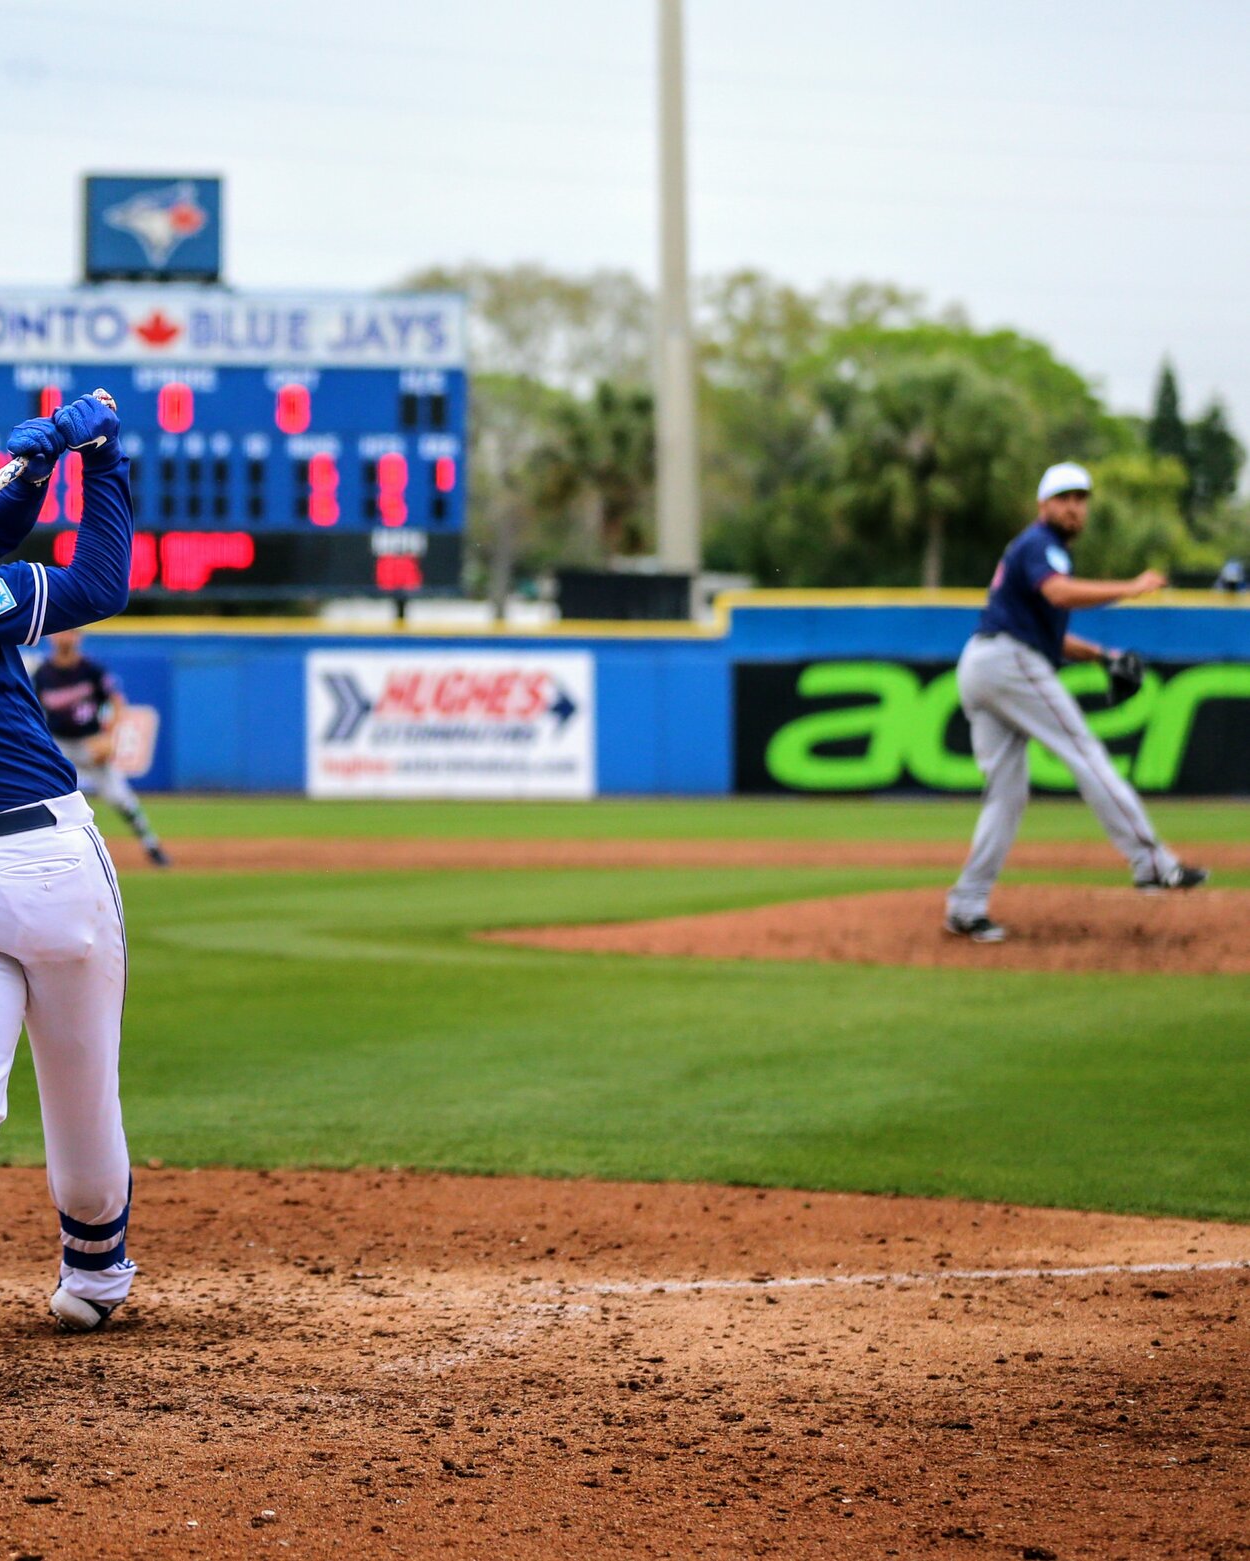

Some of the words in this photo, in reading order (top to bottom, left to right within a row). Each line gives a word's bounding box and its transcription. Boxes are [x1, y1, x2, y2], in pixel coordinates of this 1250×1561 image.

[190, 307, 308, 350] BLUE
[327, 309, 444, 351] JAYS
[374, 669, 553, 722] HUGHES
[765, 661, 1250, 791] acer
